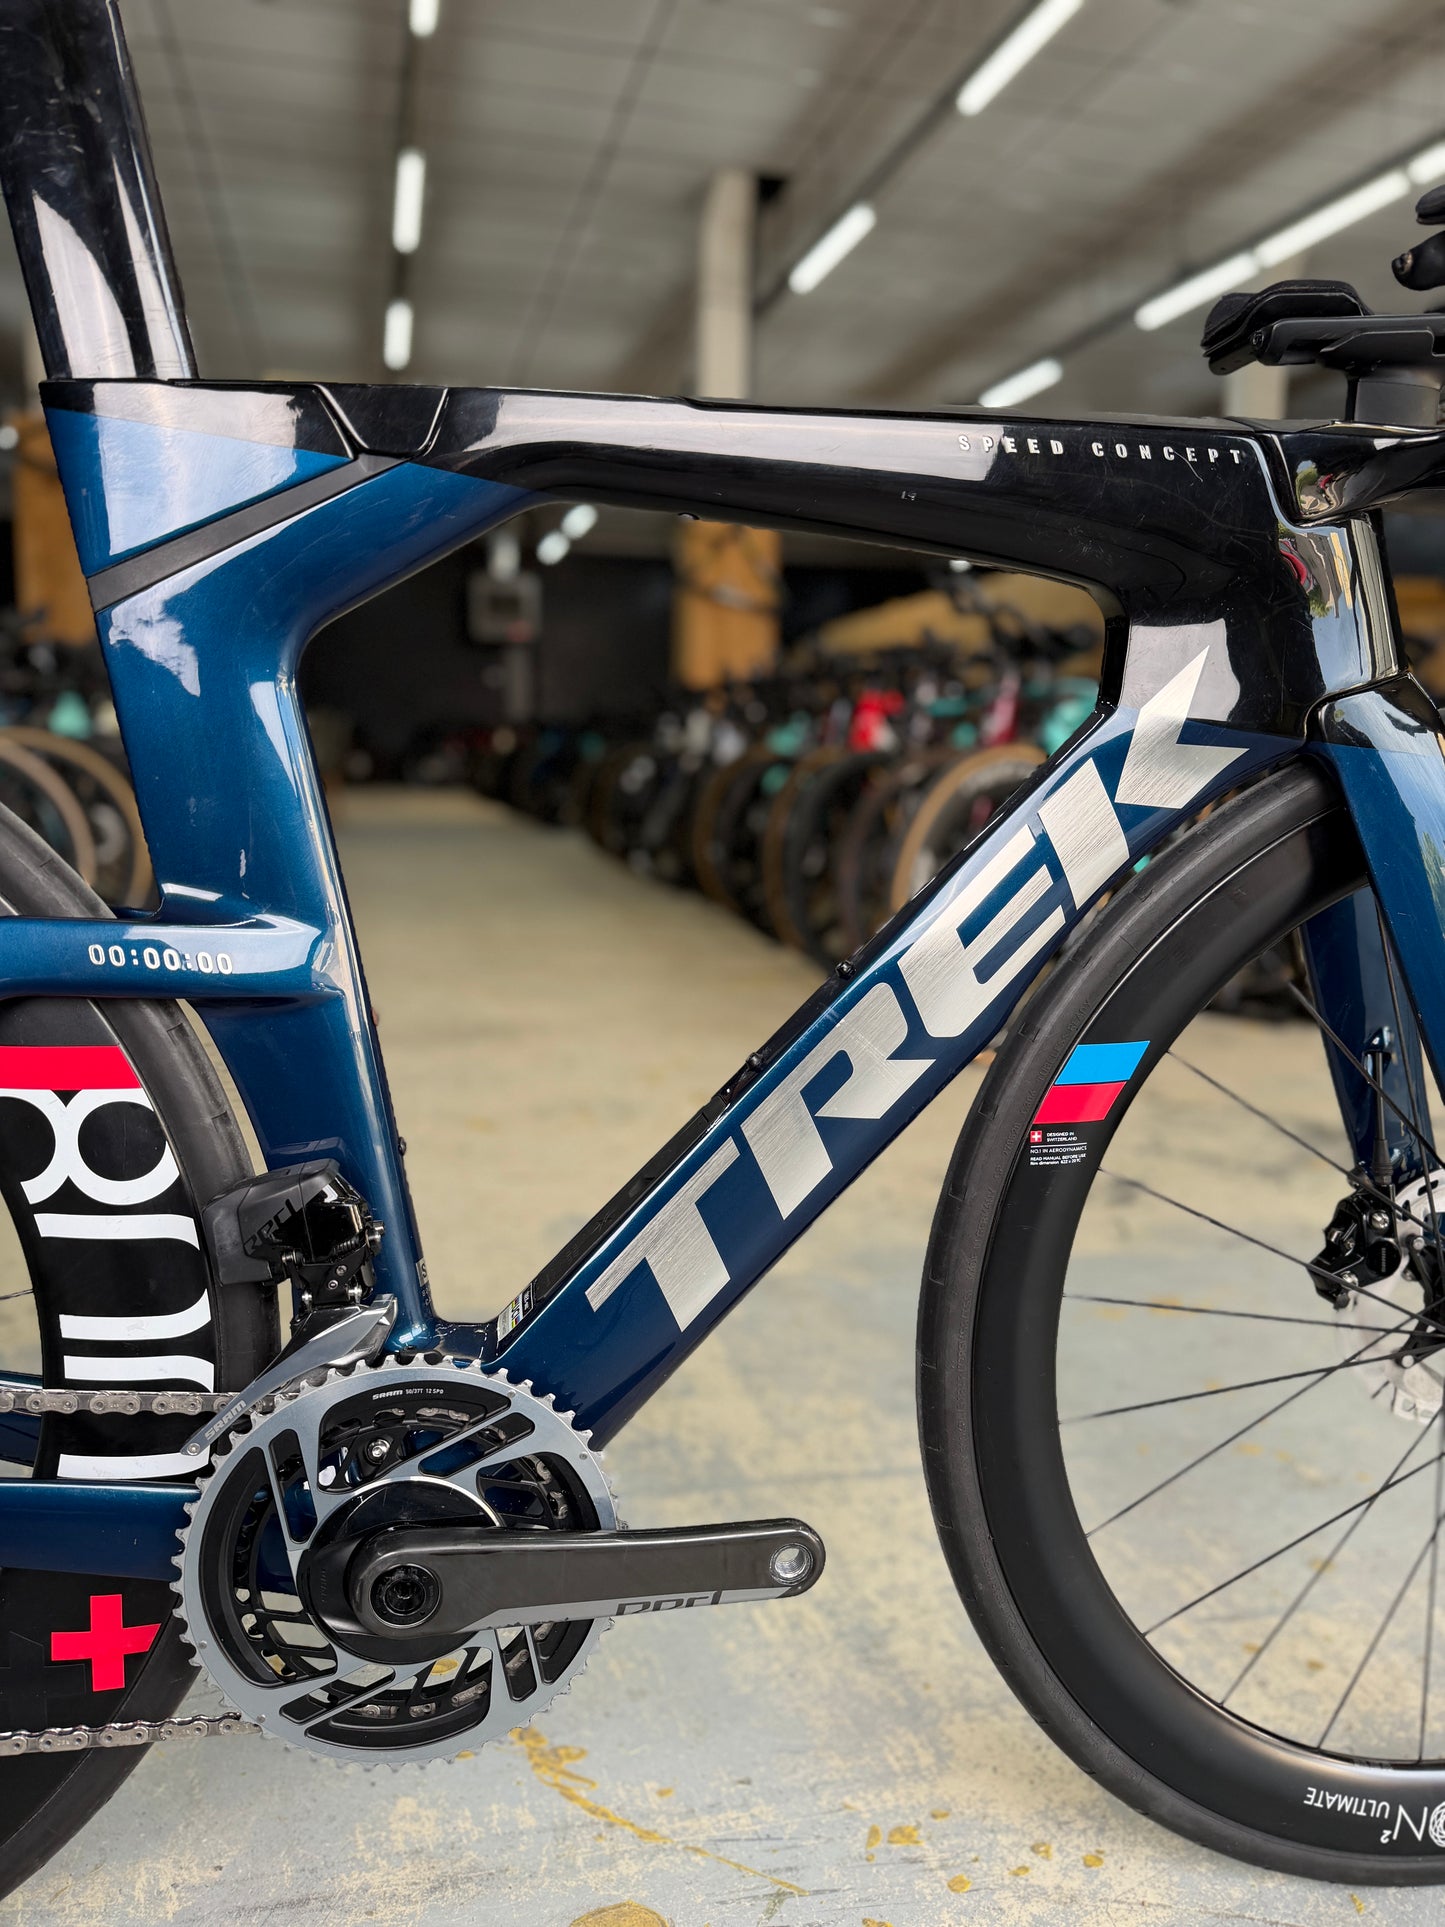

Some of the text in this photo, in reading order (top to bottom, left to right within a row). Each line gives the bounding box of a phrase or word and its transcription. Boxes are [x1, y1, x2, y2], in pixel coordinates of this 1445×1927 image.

[959, 435, 1240, 464] SPEED CONCEPT
[88, 944, 233, 975] 00:00:00
[585, 645, 1249, 1331] TREK
[372, 1389, 404, 1400] SRAM
[205, 1400, 247, 1441] SRAM
[1303, 1787, 1390, 1819] ULTIMATE
